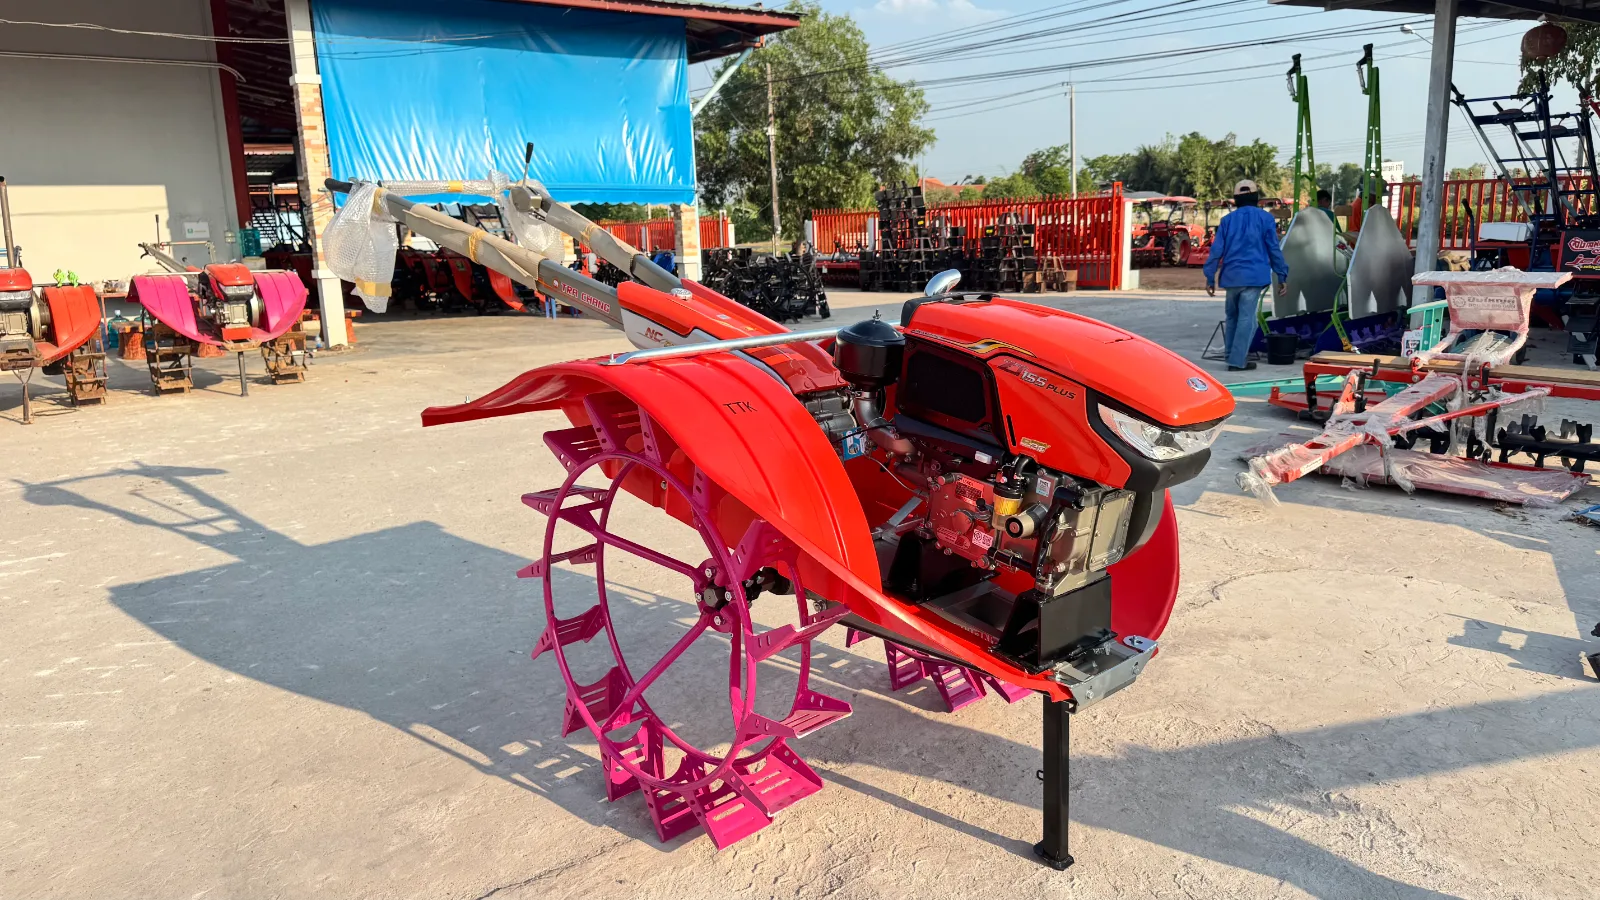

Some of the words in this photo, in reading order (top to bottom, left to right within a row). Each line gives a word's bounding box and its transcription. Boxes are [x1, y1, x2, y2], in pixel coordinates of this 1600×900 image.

[561, 282, 579, 298] TRA
[581, 292, 611, 314] CHANG
[644, 327, 664, 343] NC
[1046, 383, 1076, 400] PLUS
[722, 398, 758, 415] TTK
